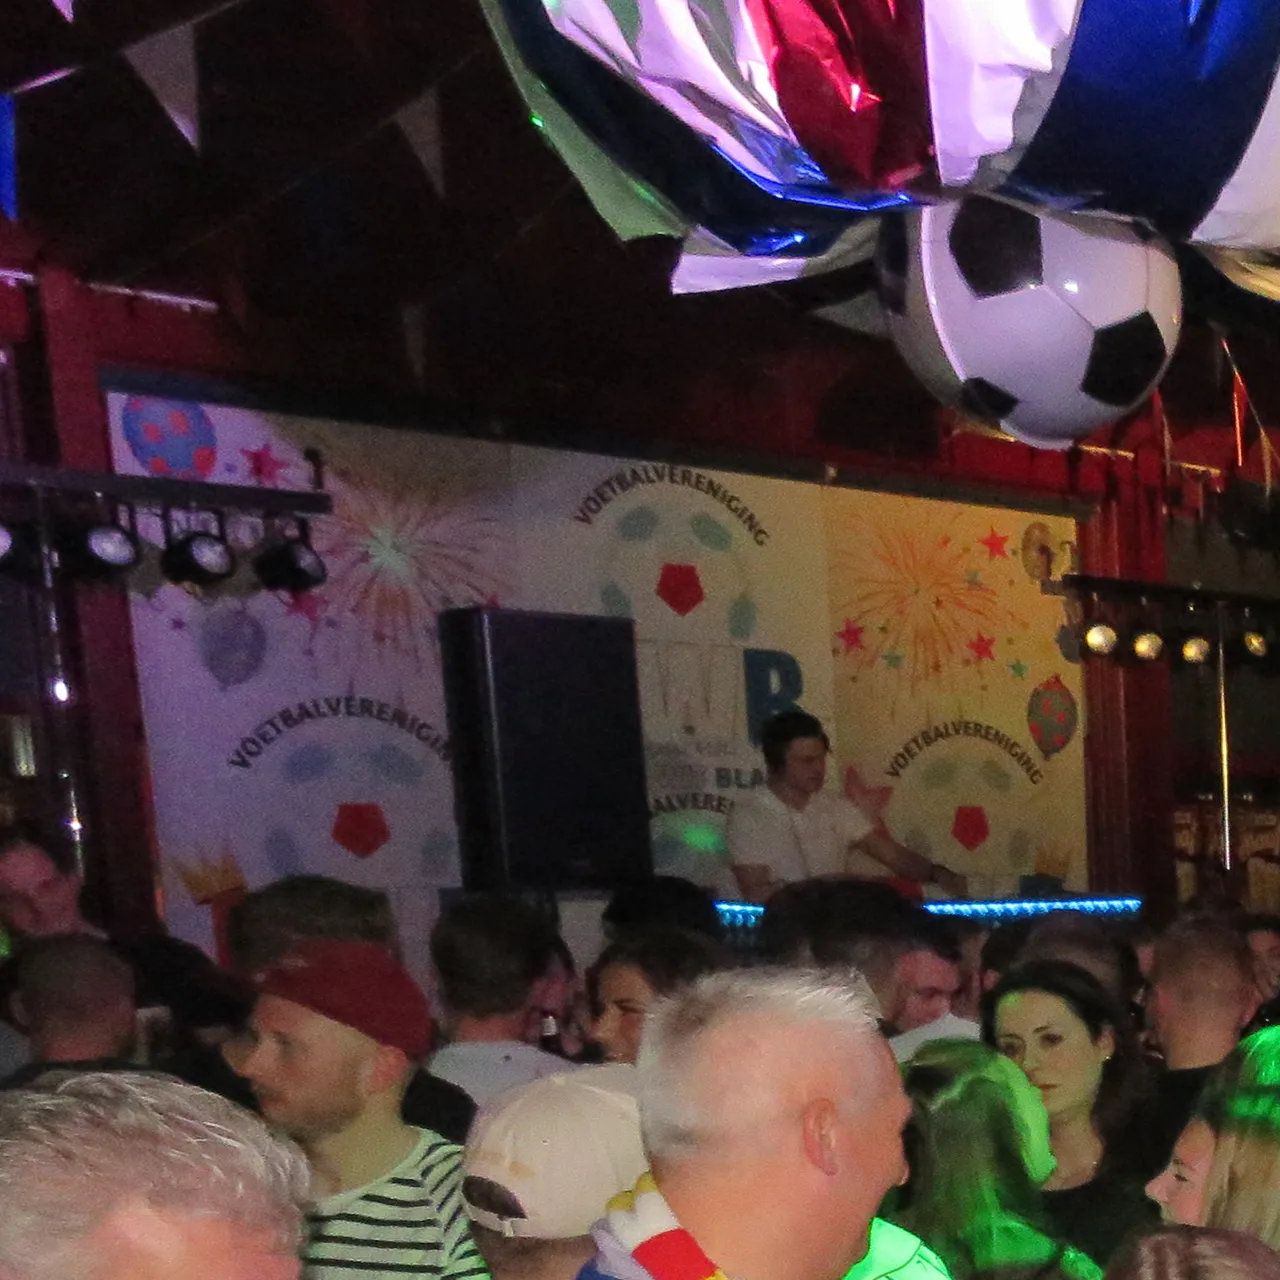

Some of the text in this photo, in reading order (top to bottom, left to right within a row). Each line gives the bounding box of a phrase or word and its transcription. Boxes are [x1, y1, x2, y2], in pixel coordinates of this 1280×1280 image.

[573, 464, 771, 547] VOETBALVERENIGING
[226, 696, 454, 771] VOETBALVERENIGIN
[885, 720, 1045, 786] VOETBALVERENIGING
